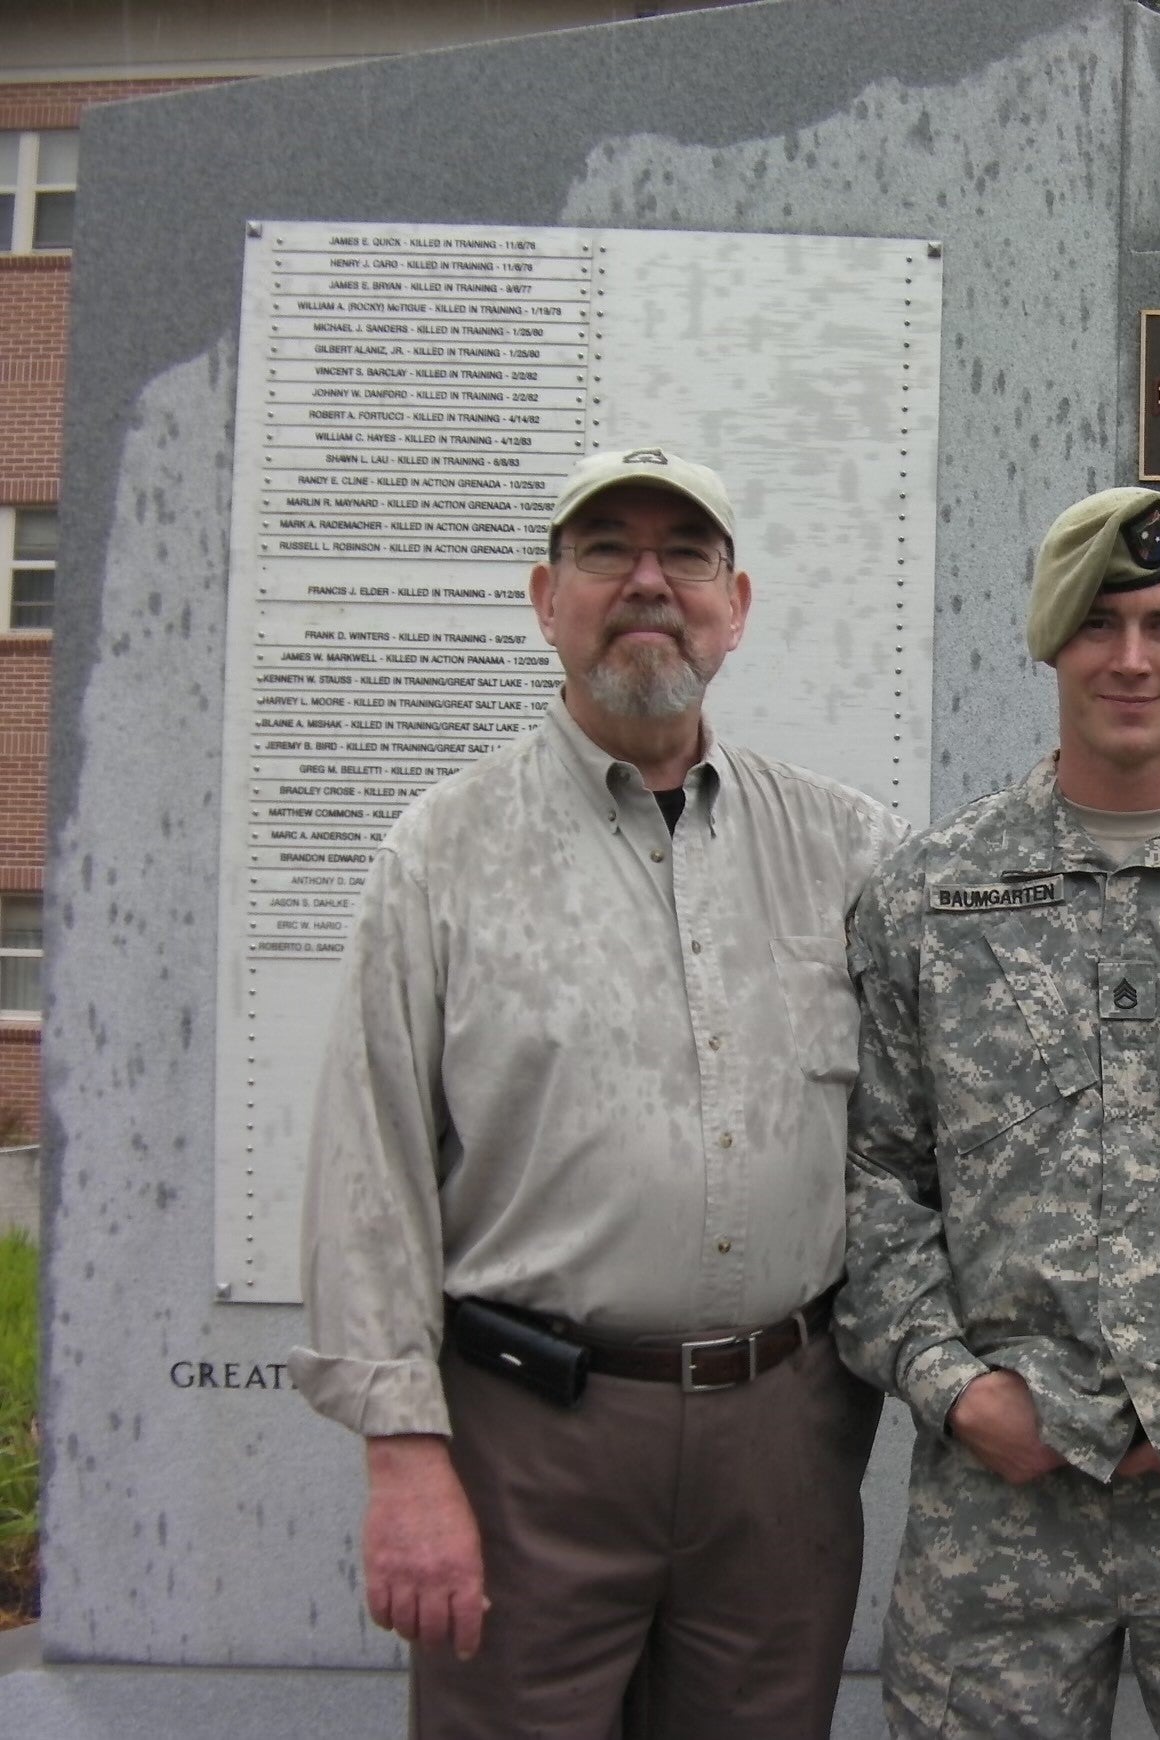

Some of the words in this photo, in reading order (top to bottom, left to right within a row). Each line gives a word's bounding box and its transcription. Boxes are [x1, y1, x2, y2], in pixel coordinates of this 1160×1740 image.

[330, 238, 359, 246] JAMES
[373, 238, 401, 246] QUICK
[410, 239, 441, 248] KILLED
[444, 240, 452, 248] IN
[456, 240, 496, 248] TRAINING
[330, 259, 360, 268] HENRY
[407, 261, 438, 270] KILLED
[441, 262, 450, 270] IN
[452, 262, 494, 271] TRAINING
[330, 281, 359, 290] JAMES
[373, 282, 402, 290] BRYAN
[411, 283, 441, 292] KILLED
[444, 283, 453, 292] IN
[456, 284, 497, 292] TRAINING
[298, 302, 335, 310] WILLIAM
[348, 303, 384, 311] (ROCKY)
[387, 304, 426, 312] McTIGUE
[435, 305, 466, 313] KILLED
[469, 305, 478, 314] IN
[481, 306, 522, 314] TRAINING
[314, 324, 352, 332] MICHAEL
[366, 324, 408, 333] SANDERS
[417, 325, 448, 334] KILLED
[451, 326, 460, 335] IN
[463, 327, 504, 335] TRAINING
[315, 345, 351, 354] GILBERT
[413, 347, 444, 356] KILLED
[447, 348, 456, 356] IN
[459, 348, 500, 357] TRAINING
[316, 367, 353, 376] VINCENT
[367, 368, 406, 377] BARCLAY
[416, 369, 447, 378] KILLED
[449, 370, 458, 379] IN
[462, 371, 503, 379] TRAINING
[512, 372, 537, 381] 2/2/82
[313, 389, 348, 397] JOHNNY
[364, 390, 408, 399] DANFORD
[417, 391, 448, 400] KILLED
[450, 392, 459, 400] IN
[463, 392, 504, 401] TRAINING
[513, 393, 538, 402] 2/2/82
[309, 410, 344, 419] ROBERT
[359, 411, 404, 421] FORTUCCI
[413, 413, 444, 422] KILLED
[447, 414, 456, 422] IN
[459, 414, 500, 423] TRAINING
[316, 433, 353, 442] WILLIAM
[367, 434, 396, 442] HAYES
[405, 434, 436, 444] KILLED
[439, 435, 448, 444] IN
[451, 436, 492, 445] TRAINING
[326, 455, 358, 463] SHAWN
[398, 456, 428, 465] KILLED
[431, 457, 440, 465] IN
[444, 457, 485, 466] TRAINING
[298, 476, 328, 484] RANDY
[342, 477, 368, 486] CLINE
[377, 477, 408, 487] KILLED
[411, 478, 420, 487] IN
[422, 478, 455, 487] ACTION
[458, 480, 501, 488] GRENADA
[510, 481, 545, 490] 10/25/83
[287, 498, 321, 506] MARLIN
[335, 499, 378, 507] MAYNARD
[387, 500, 418, 509] KILLED
[421, 500, 430, 509] IN
[433, 500, 466, 509] ACTION
[468, 501, 511, 510] GRENADA
[320, 521, 382, 530] RADEMACHER
[391, 522, 422, 531] KILLED
[425, 523, 434, 531] IN
[436, 523, 469, 531] ACTION
[472, 524, 515, 532] GRENADA
[280, 542, 319, 550] RUSSELL
[333, 543, 380, 551] ROBINSON
[390, 544, 420, 553] KILLED
[424, 544, 432, 553] IN
[435, 545, 468, 553] ACTION
[471, 546, 513, 554] GRENADA
[308, 586, 347, 595] FRANCIS
[360, 587, 389, 596] ELDER
[398, 588, 429, 597] KILLED
[432, 589, 441, 597] IN
[444, 589, 485, 598] TRAINING
[305, 631, 334, 639] FRANK
[350, 632, 390, 640] WINTERS
[399, 633, 430, 642] KILLED
[433, 634, 442, 642] IN
[445, 634, 486, 643] TRAINING
[282, 653, 311, 661] JAMES
[327, 654, 376, 662] MARKWELL
[386, 654, 417, 663] KILLED
[420, 655, 429, 663] IN
[432, 655, 465, 664] ACTION
[467, 656, 505, 664] PANAMA
[261, 674, 304, 683] KENNETH
[360, 676, 390, 685] KILLED
[393, 677, 402, 685] IN
[405, 677, 474, 686] TRAINING/GREAT
[477, 678, 497, 687] SALT
[500, 679, 522, 688] LAKE
[261, 696, 297, 705] HARVEY
[311, 697, 344, 706] MOORE
[354, 698, 385, 707] KILLED
[388, 699, 397, 708] IN
[400, 699, 472, 709] TRAINING/GREAT
[475, 701, 495, 709] SALT
[498, 701, 522, 710] LAKE
[260, 719, 294, 728] BLAINE
[307, 720, 342, 728] MISHAK
[351, 720, 382, 730] KILLED
[385, 721, 394, 730] IN
[397, 721, 470, 731] TRAINING/GREAT
[473, 723, 493, 732] SALT
[496, 724, 519, 732] LAKE
[266, 742, 301, 750] JEREMY
[316, 742, 337, 750] BIRD
[346, 743, 377, 751] KILLED
[380, 743, 389, 752] IN
[393, 744, 465, 752] TRAINING/GREAT
[468, 745, 489, 753] SALT
[300, 765, 325, 774] GREG
[391, 767, 422, 776] KILLED
[425, 767, 434, 776] IN
[280, 786, 320, 795] BRADLEY
[324, 787, 354, 796] CROSE
[364, 788, 395, 797] KILLED
[398, 788, 407, 797] IN
[269, 808, 313, 817] MATTHEW
[315, 810, 364, 818] COMMONS
[271, 831, 297, 839] MARC
[311, 832, 361, 841] ANDERSON
[280, 854, 325, 862] BRANDON
[328, 854, 366, 863] EDWARD
[292, 877, 334, 885] ANTHONY
[939, 883, 1054, 907] BAUMGARTEN
[271, 899, 300, 907] JASON
[277, 921, 298, 930] ERIC
[169, 1361, 299, 1389] GREAT
